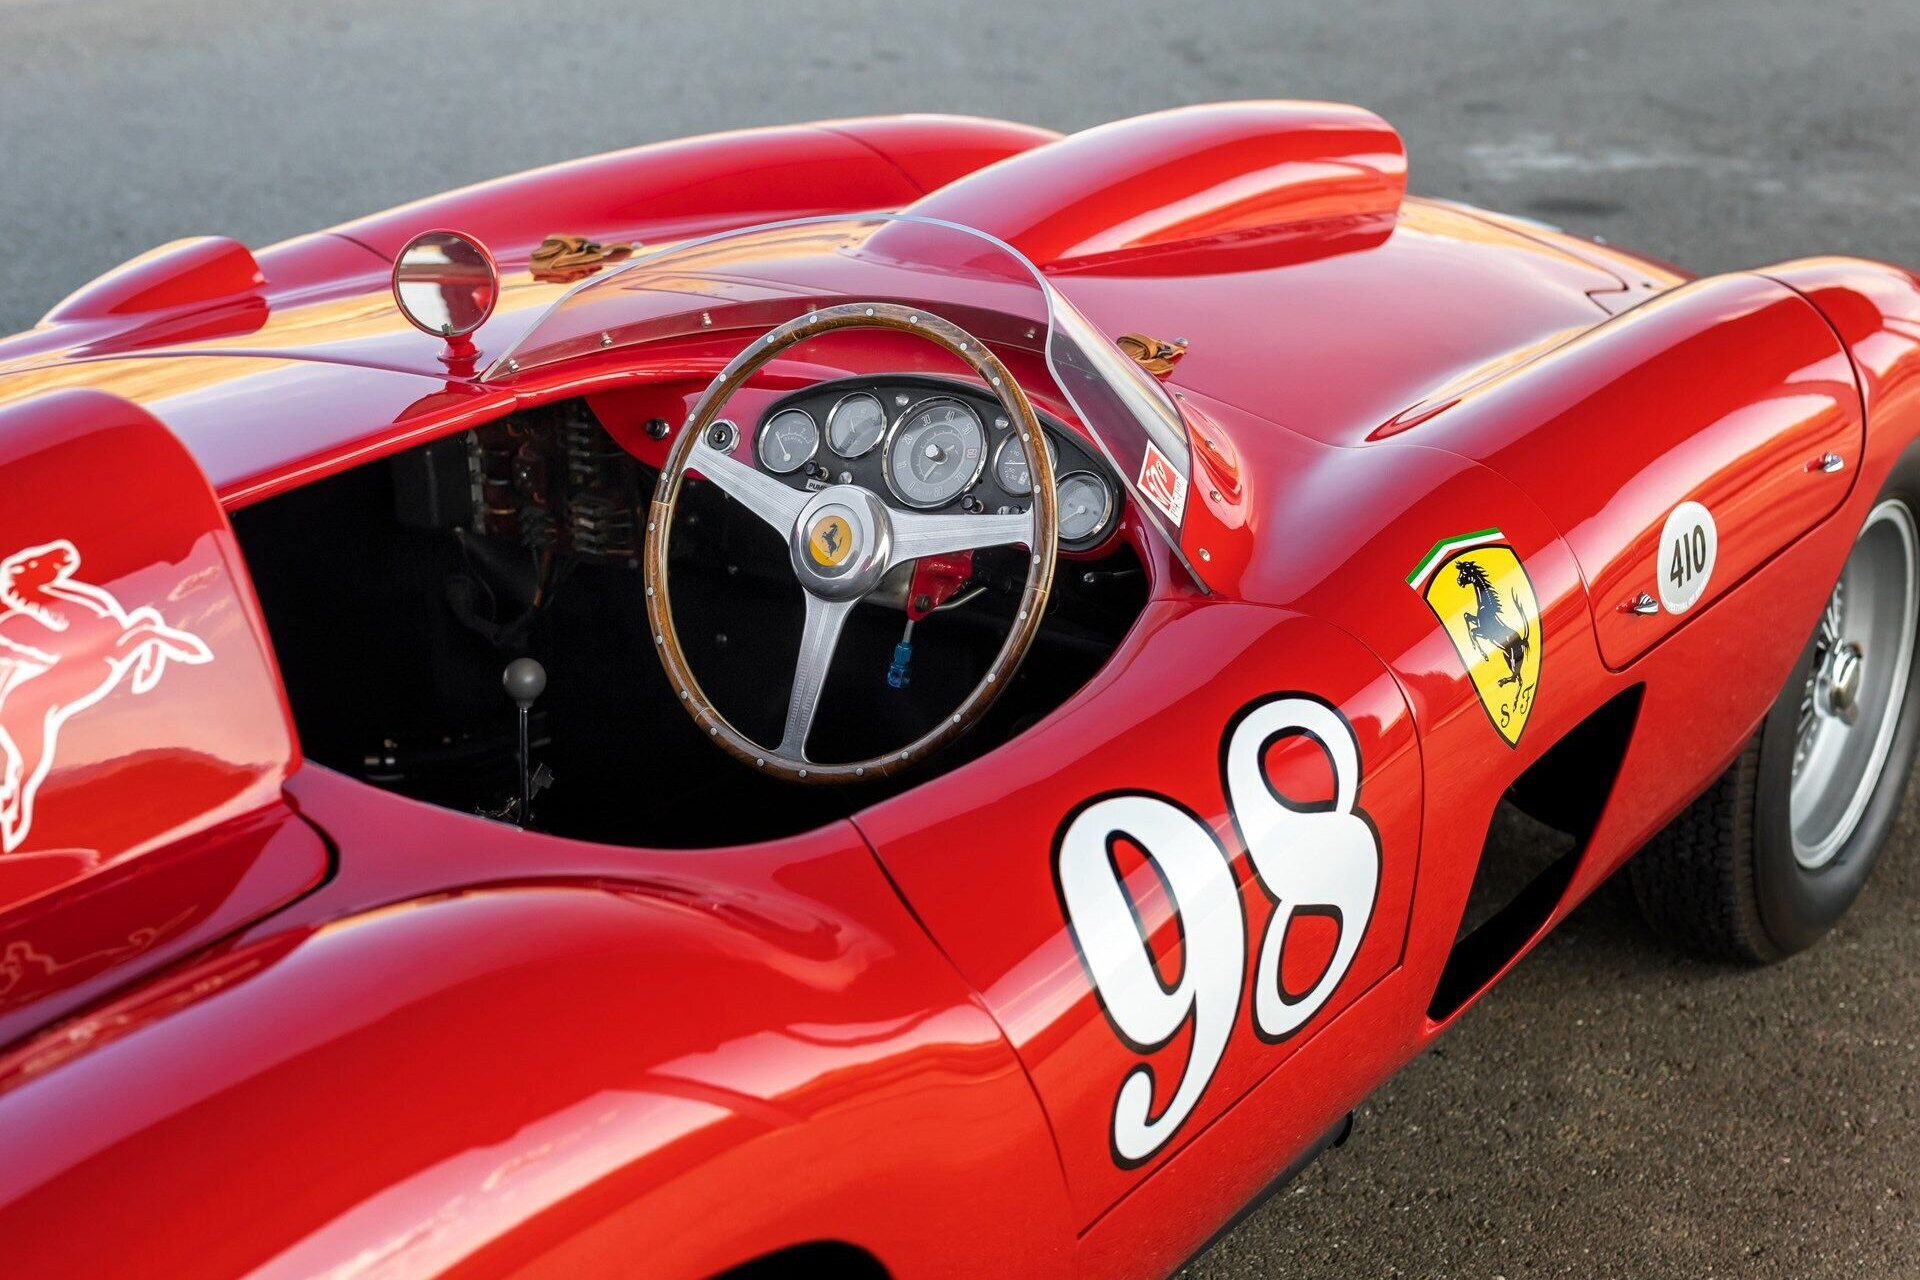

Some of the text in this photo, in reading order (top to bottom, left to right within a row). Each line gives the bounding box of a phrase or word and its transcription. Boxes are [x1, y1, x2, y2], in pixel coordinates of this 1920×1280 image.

[921, 414, 932, 427] 30
[945, 411, 955, 423] 40
[961, 423, 974, 435] 50
[902, 433, 913, 445] 20
[966, 448, 977, 459] 60
[955, 472, 966, 483] 70
[934, 486, 943, 498] 80
[1670, 524, 1706, 589] 410
[1501, 703, 1510, 728] S
[1050, 691, 1383, 1170] 98
